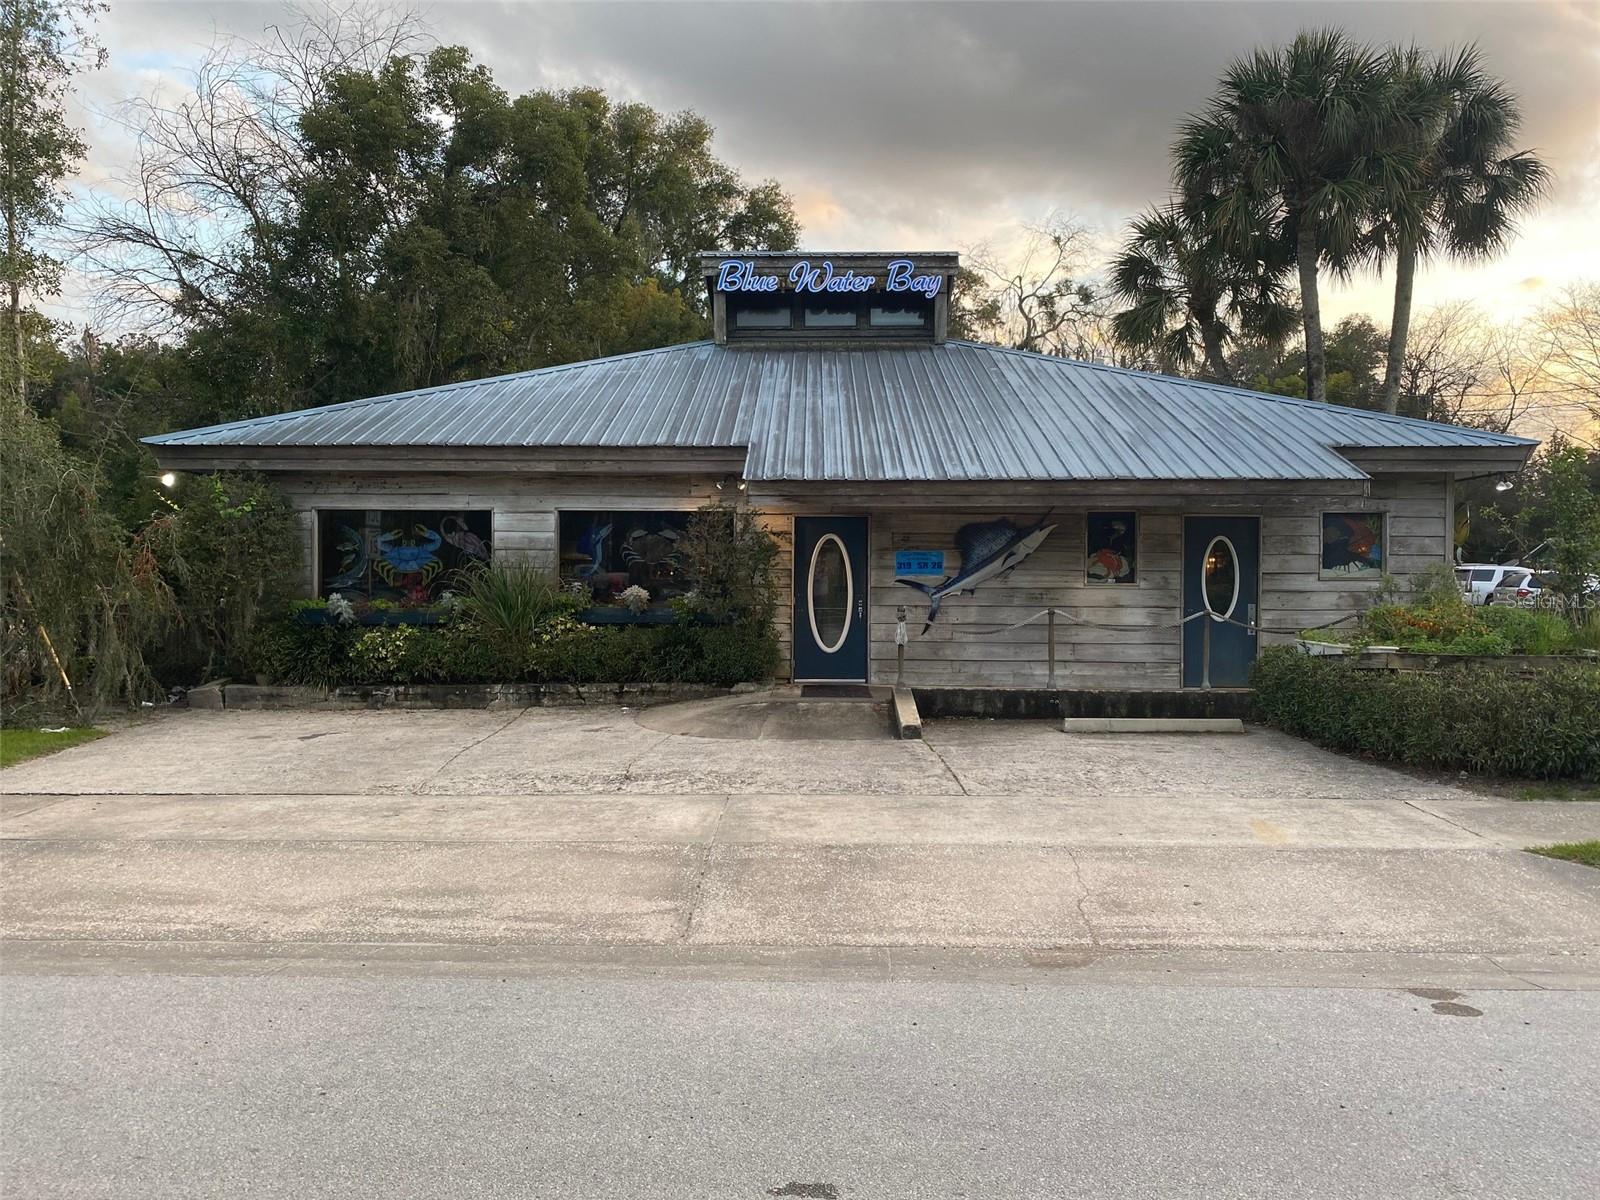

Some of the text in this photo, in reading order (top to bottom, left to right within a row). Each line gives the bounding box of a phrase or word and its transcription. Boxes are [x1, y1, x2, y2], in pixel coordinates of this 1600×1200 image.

[717, 259, 942, 298] Blue Water Bay
